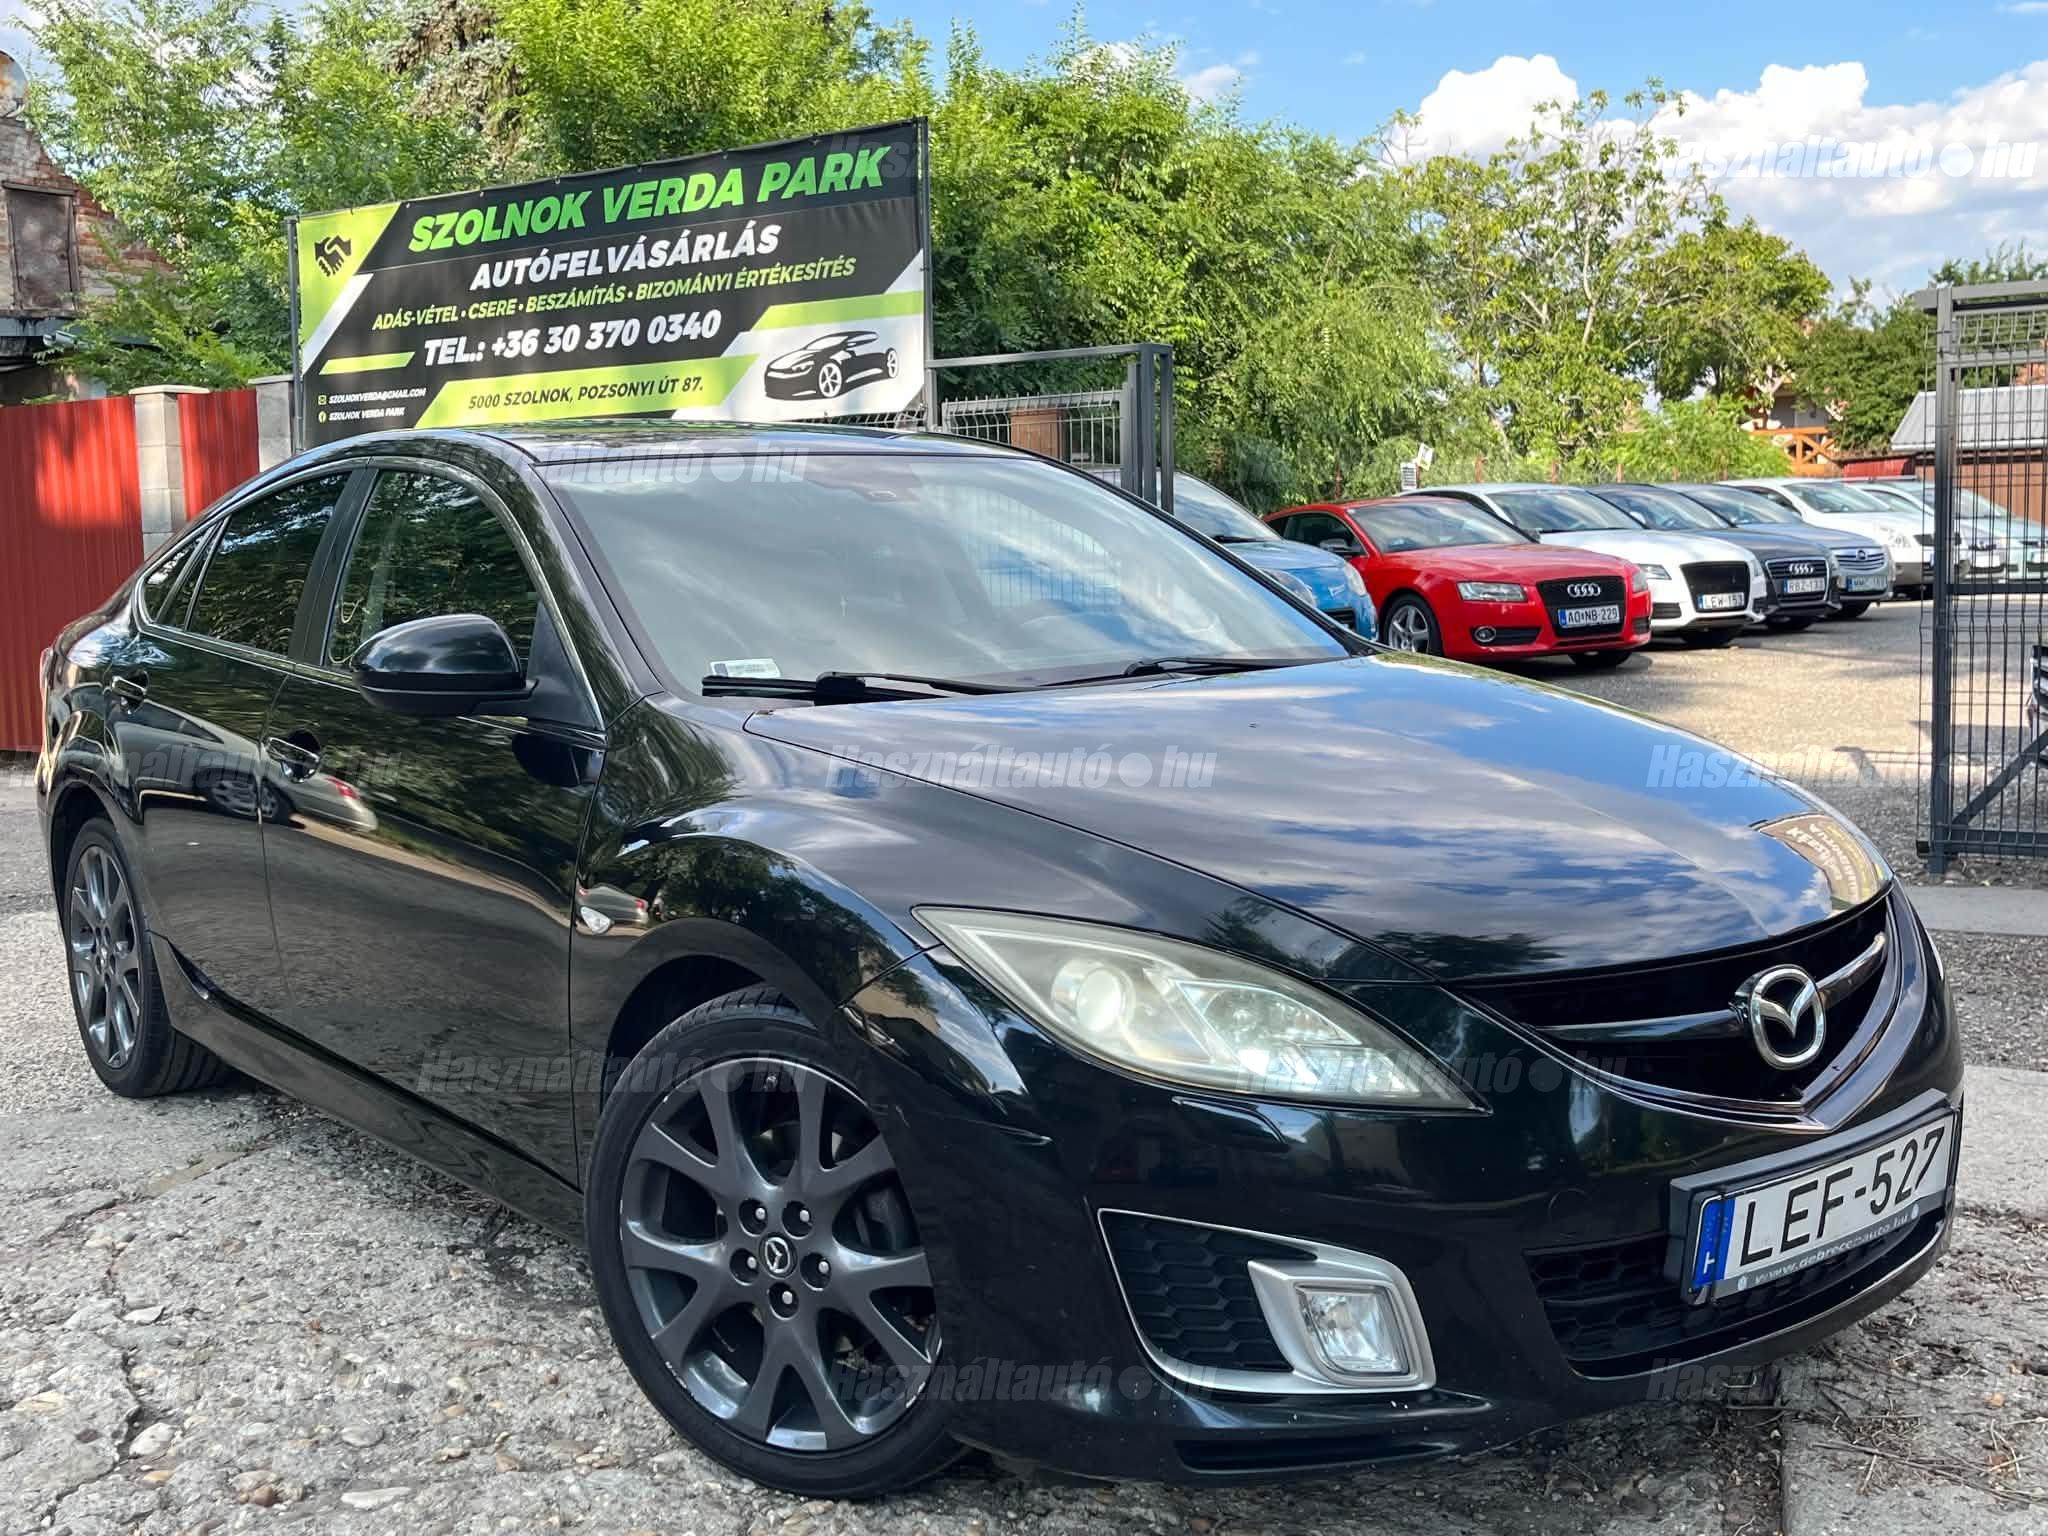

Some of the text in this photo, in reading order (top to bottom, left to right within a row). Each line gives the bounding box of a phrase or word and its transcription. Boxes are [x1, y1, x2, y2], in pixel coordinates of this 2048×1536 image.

[408, 190, 594, 252] SZOLNOK
[602, 167, 745, 224] VERDA
[757, 146, 892, 203] PARK
[469, 220, 782, 291] AUTÓFELVÁSÁRLÁS
[372, 256, 857, 331] ADÁS-VÉTEL CSERE BESZÁMÍTÁS BIZOMÁNYI ÉRTÉKESÍTÉS
[424, 309, 722, 367] TEL.: +36 30 370 0340
[468, 376, 704, 410] 5000 SZOLNOK, POZSONYI ÚT 87.
[1740, 1126, 1945, 1267] LEF-527
